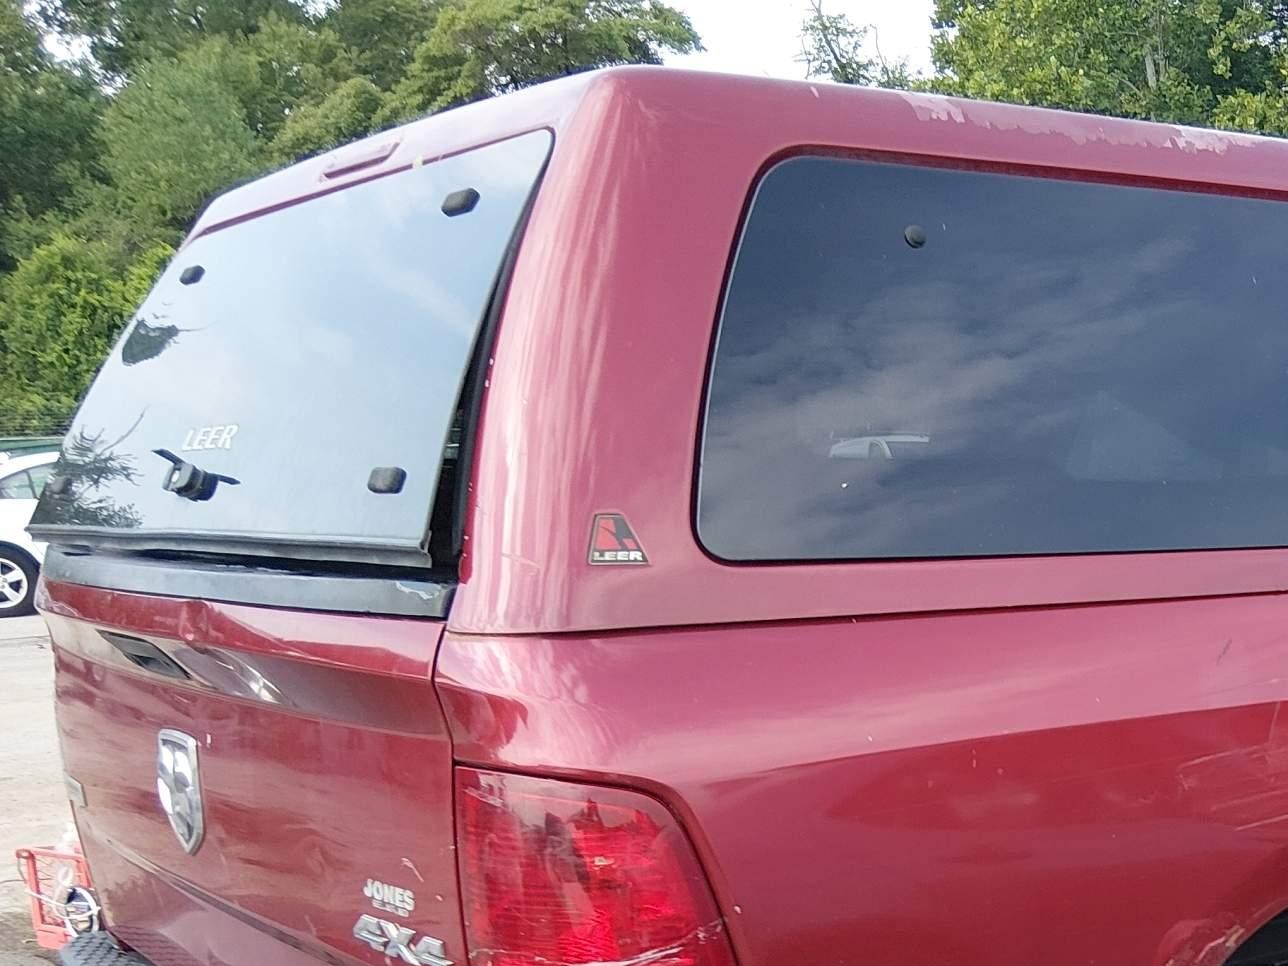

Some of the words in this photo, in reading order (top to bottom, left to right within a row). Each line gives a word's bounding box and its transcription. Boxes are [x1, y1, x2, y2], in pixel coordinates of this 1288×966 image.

[181, 424, 240, 451] LEER
[592, 550, 643, 561] LEER
[363, 878, 415, 911] JONES
